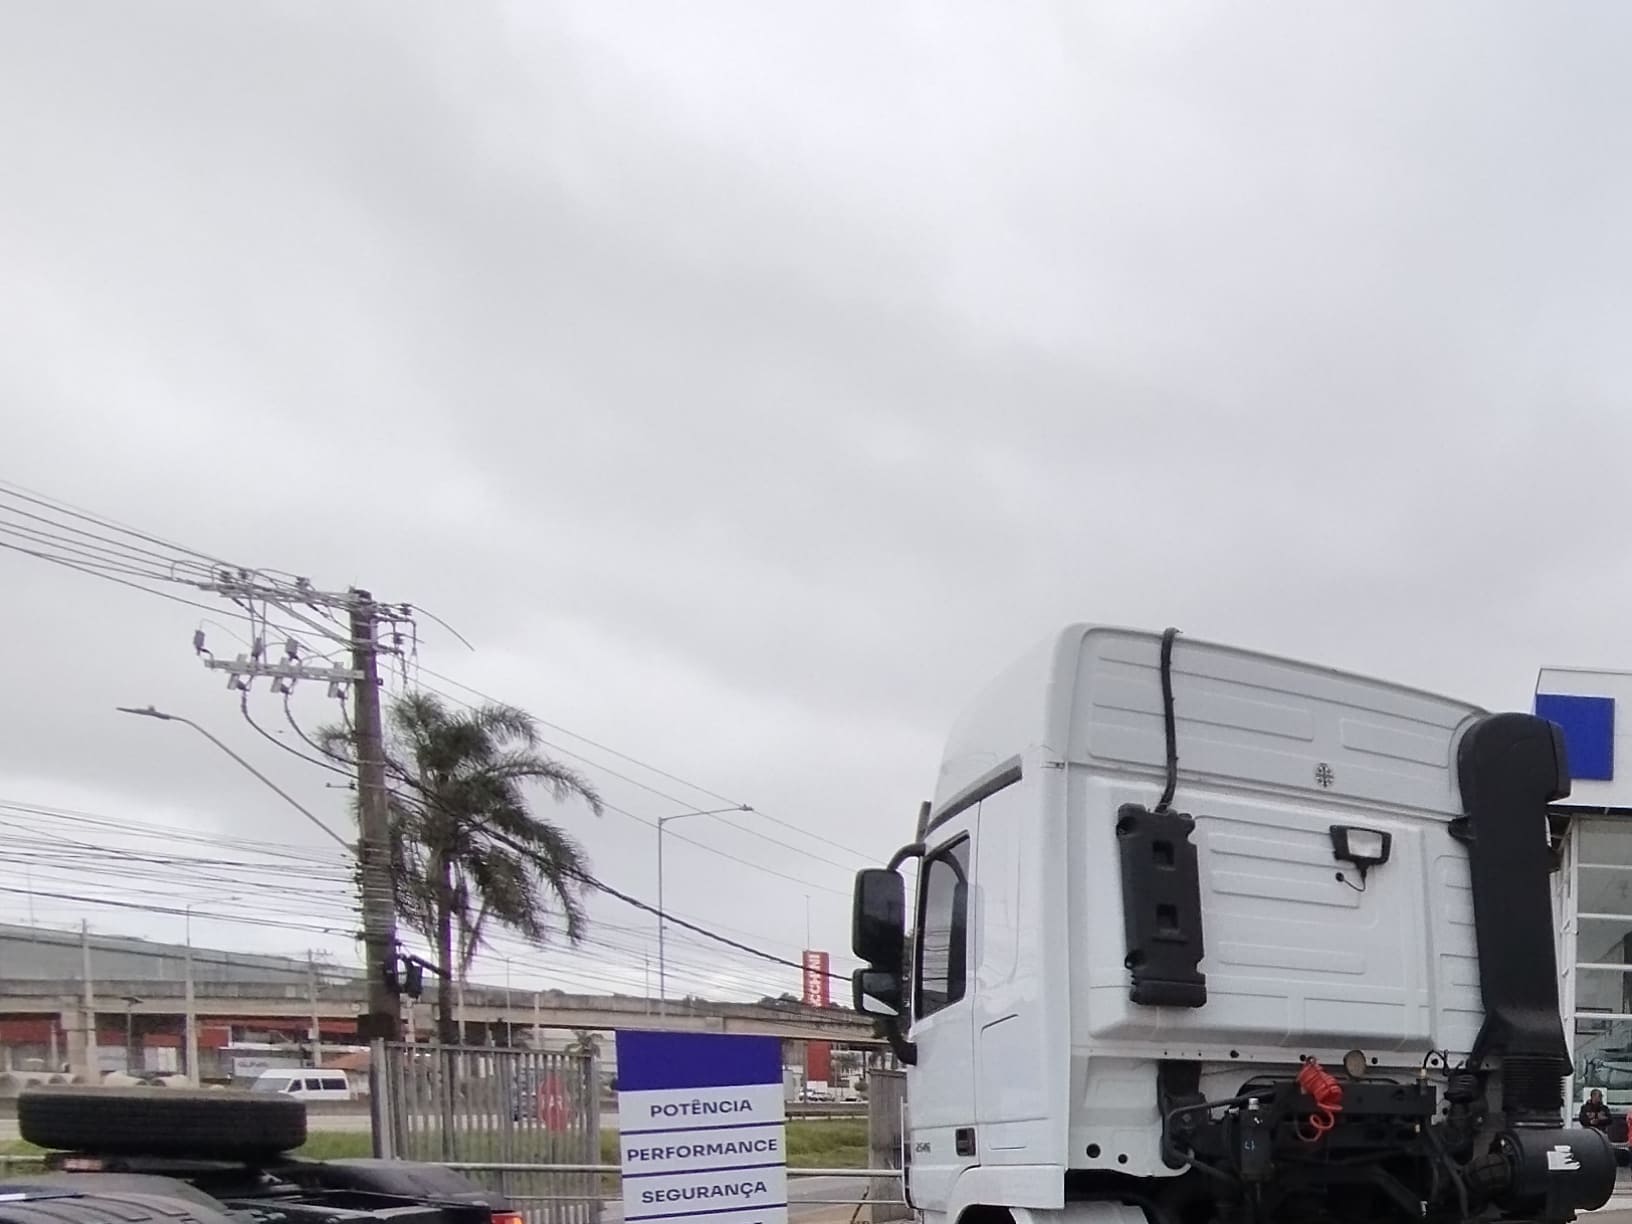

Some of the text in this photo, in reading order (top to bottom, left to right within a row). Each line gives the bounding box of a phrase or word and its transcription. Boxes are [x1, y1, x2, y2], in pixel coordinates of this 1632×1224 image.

[650, 1099, 752, 1118] POTÊNCIA
[627, 1138, 778, 1162] PERFORMANCE
[641, 1181, 767, 1204] SEGURANÇA
